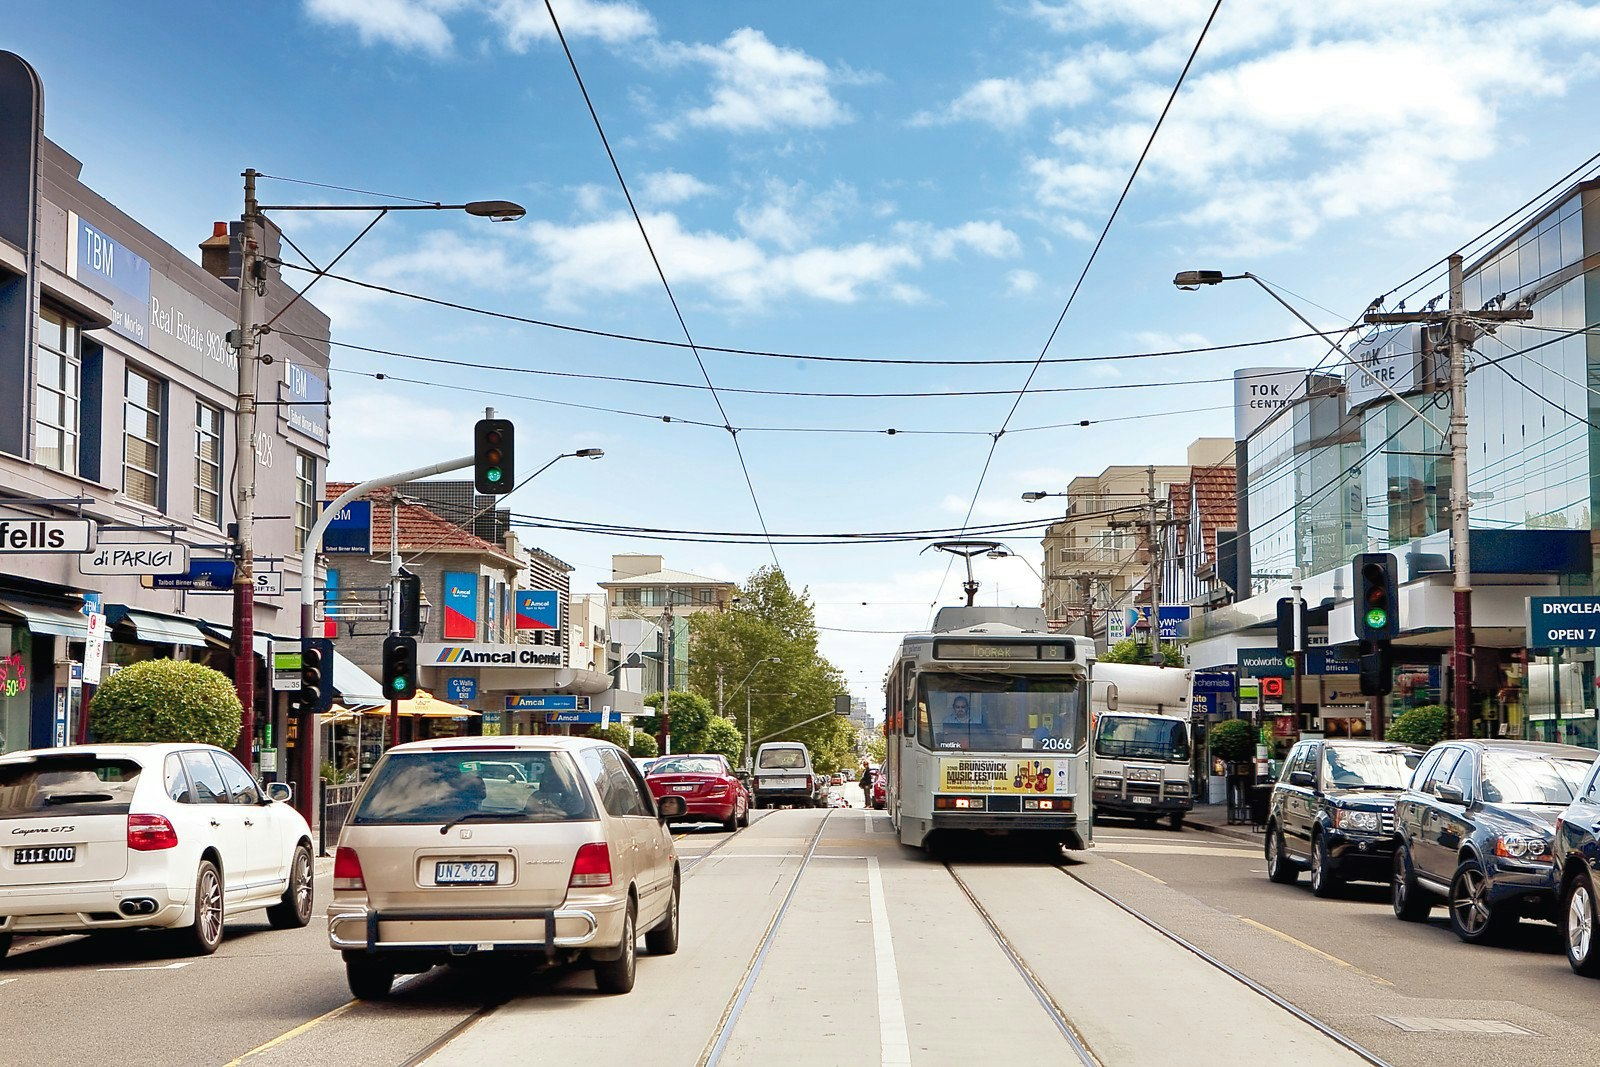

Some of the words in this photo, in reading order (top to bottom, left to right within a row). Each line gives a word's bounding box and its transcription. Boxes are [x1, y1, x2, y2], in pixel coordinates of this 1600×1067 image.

[84, 226, 114, 278] TBM
[111, 308, 124, 326] ner
[124, 312, 144, 340] Morley
[152, 296, 174, 336] Real
[176, 310, 204, 352] Estate
[206, 329, 226, 364] 9826
[1360, 347, 1381, 368] TOK
[1386, 343, 1396, 364] H
[291, 364, 308, 400] TBM
[1250, 384, 1280, 396] TOK
[0, 522, 66, 548] fells
[93, 551, 109, 566] di
[113, 550, 173, 568] PARIGI
[257, 575, 268, 586] S
[1548, 629, 1585, 640] OPEN
[1588, 629, 1597, 640] 7
[460, 650, 516, 664] Amcal
[1243, 656, 1283, 666] woolworths
[1042, 738, 1072, 750] 2066
[959, 763, 1007, 772] BRUNSWICK
[947, 772, 973, 781] MUSIC
[974, 772, 1008, 781] FESTIVAL
[12, 828, 49, 837] Cayenne
[438, 865, 462, 878] UNZ
[472, 865, 495, 878] 826
